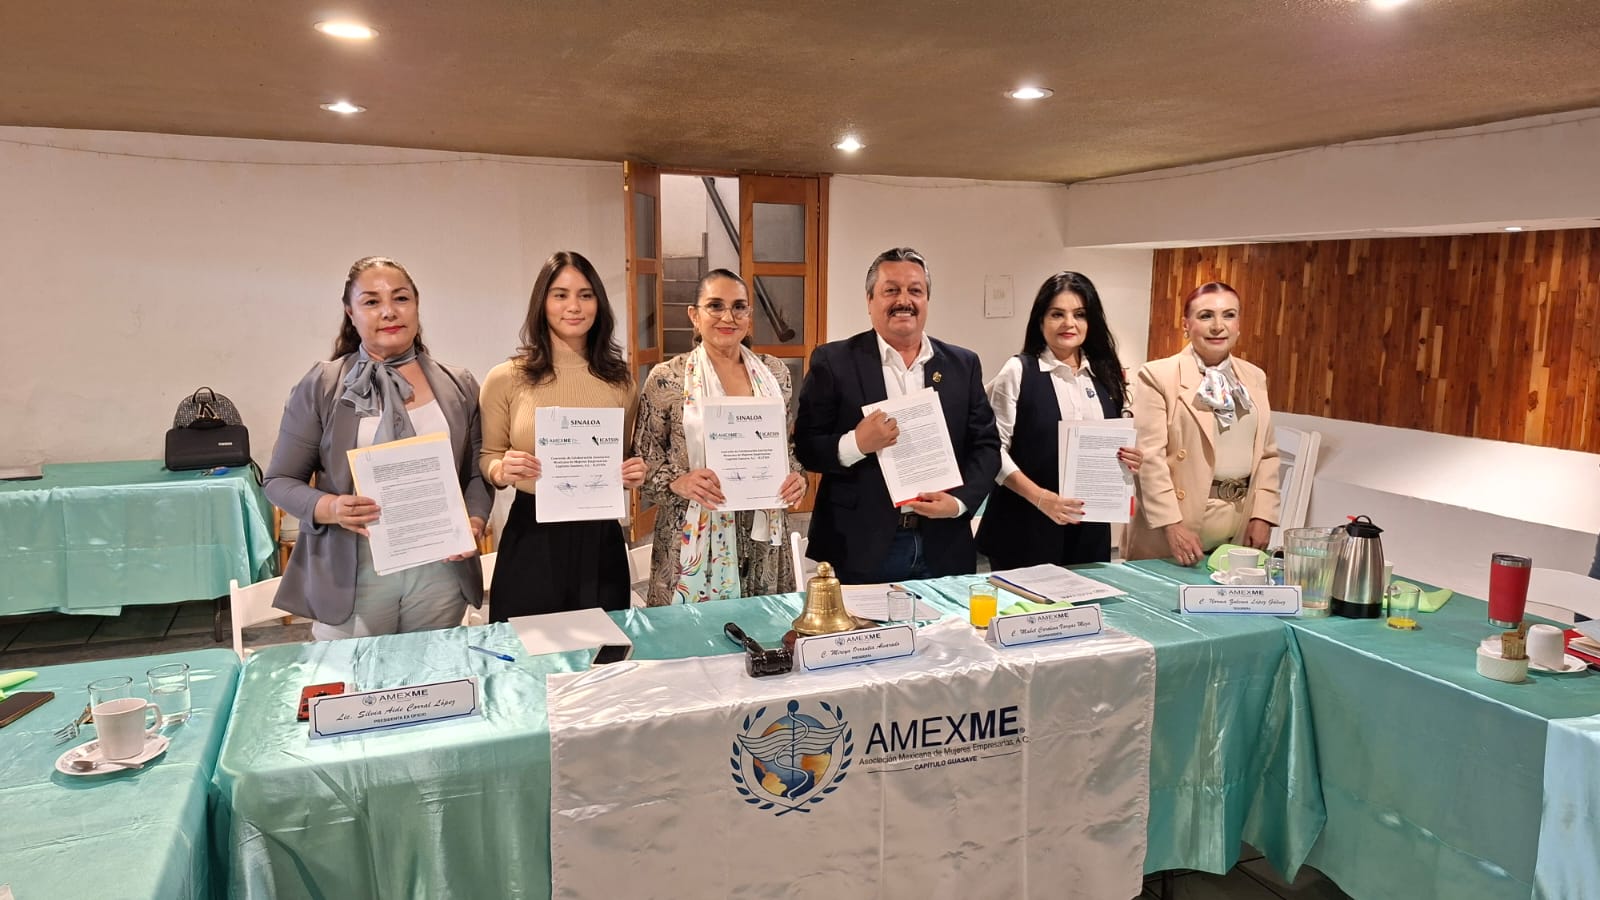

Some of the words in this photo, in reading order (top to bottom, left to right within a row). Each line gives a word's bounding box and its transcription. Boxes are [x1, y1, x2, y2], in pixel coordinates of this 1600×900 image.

[1037, 612, 1068, 621] AMEXME
[846, 633, 880, 643] AMEXME
[379, 689, 428, 701] AMEXME
[336, 713, 353, 721] Lic.
[357, 710, 382, 719] Silvia
[406, 701, 432, 712] Corral
[865, 705, 1019, 755] AMEXME
[858, 753, 897, 766] Asociación
[898, 751, 932, 761] Mexicana
[933, 748, 943, 757] de
[943, 746, 971, 756] Mujeres
[972, 739, 1014, 751] Empresarias
[947, 756, 977, 765] GUASAVE
